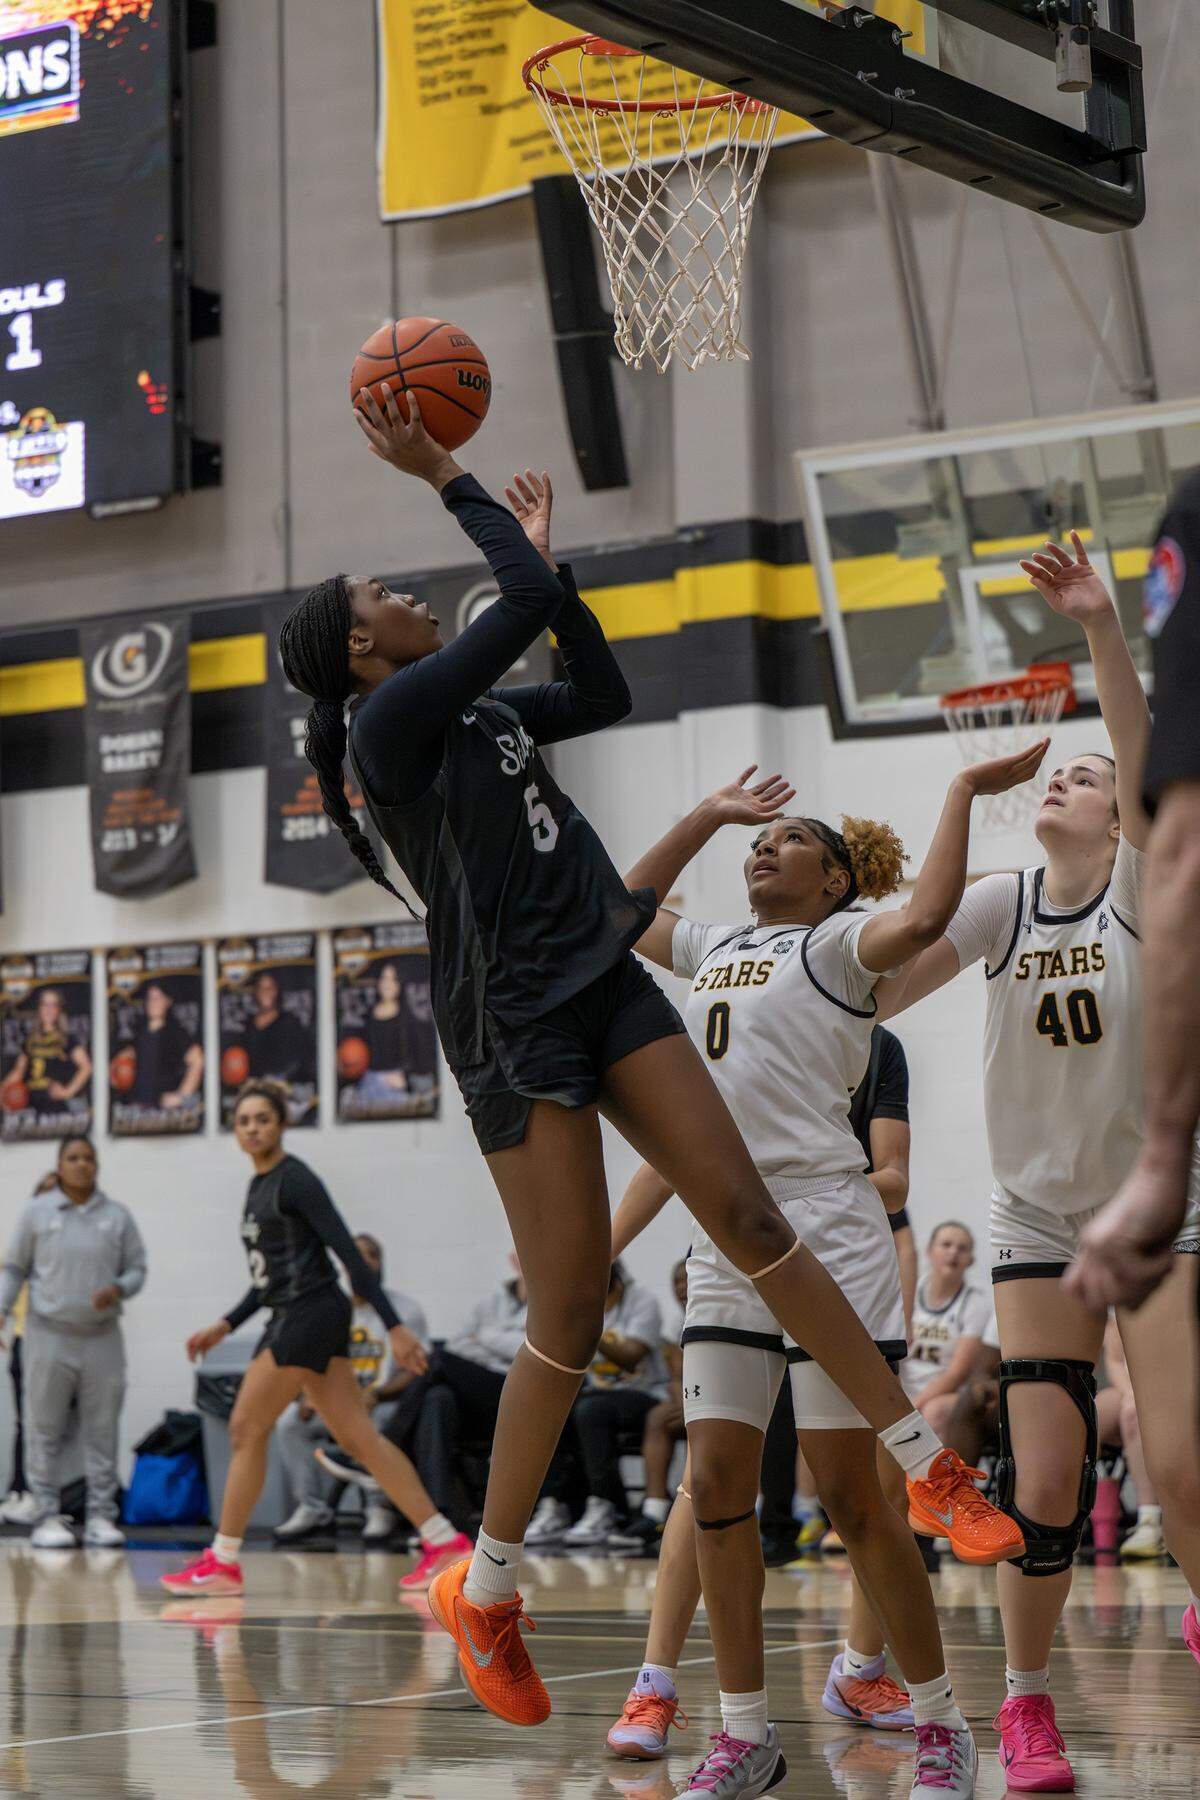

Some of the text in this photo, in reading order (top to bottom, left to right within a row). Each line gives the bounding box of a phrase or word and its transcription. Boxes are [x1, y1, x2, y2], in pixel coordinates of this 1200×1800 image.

[6, 312, 42, 371] 1
[523, 781, 560, 852] 5
[693, 960, 775, 993] STARS
[1015, 942, 1106, 980] STARS
[706, 1001, 731, 1061] 0
[1036, 988, 1103, 1047] 40
